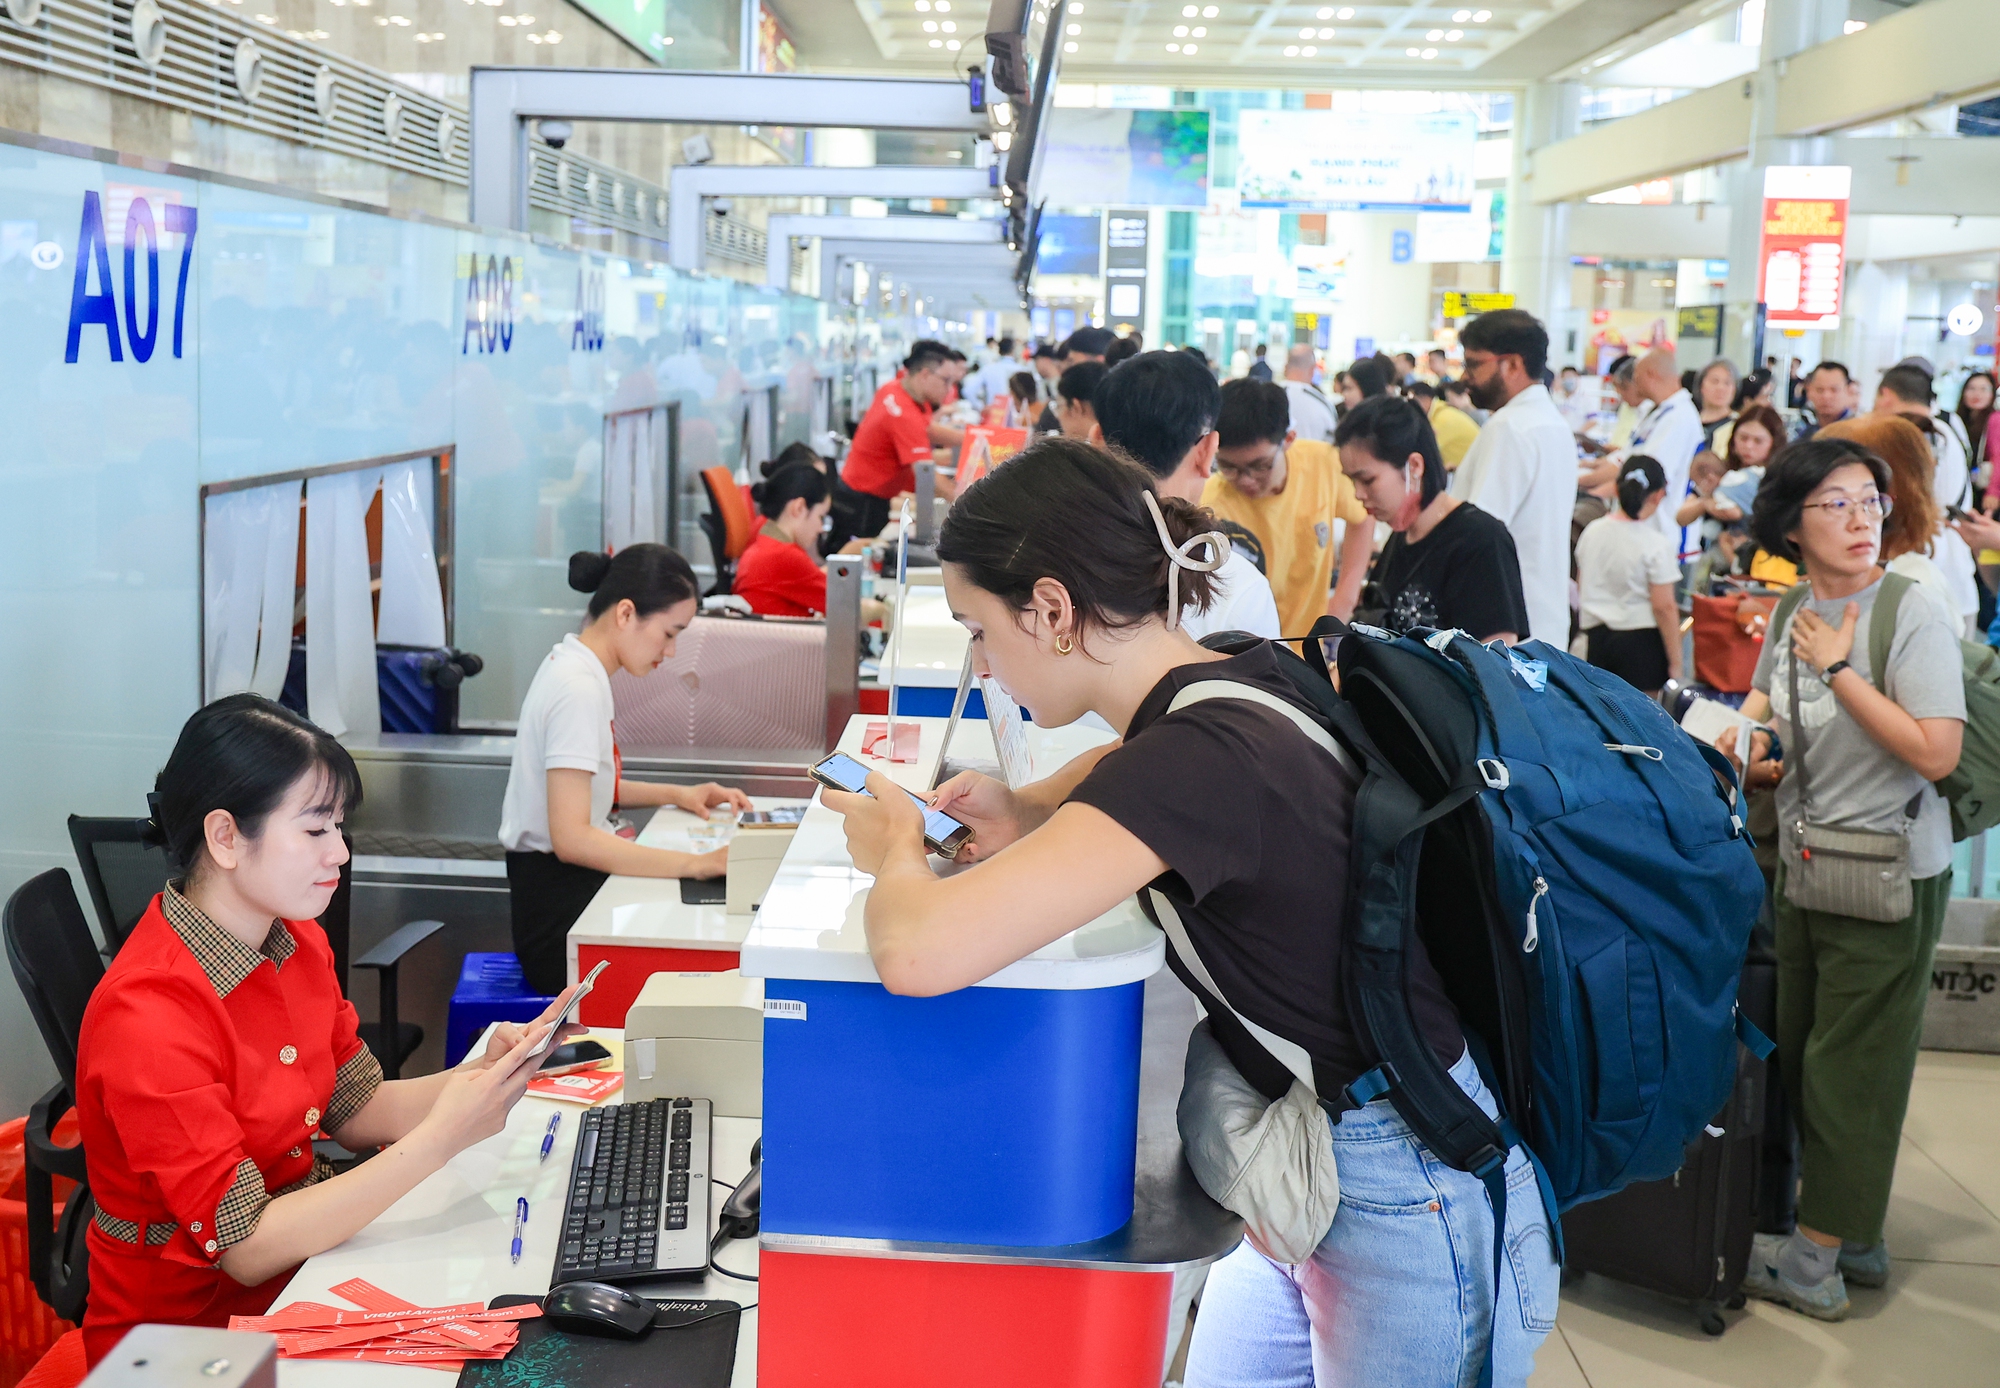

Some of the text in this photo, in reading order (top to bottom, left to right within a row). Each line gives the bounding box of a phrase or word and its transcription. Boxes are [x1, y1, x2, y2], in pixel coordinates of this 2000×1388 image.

[65, 190, 198, 363] A07
[1392, 230, 1414, 263] B
[462, 253, 513, 354] A08
